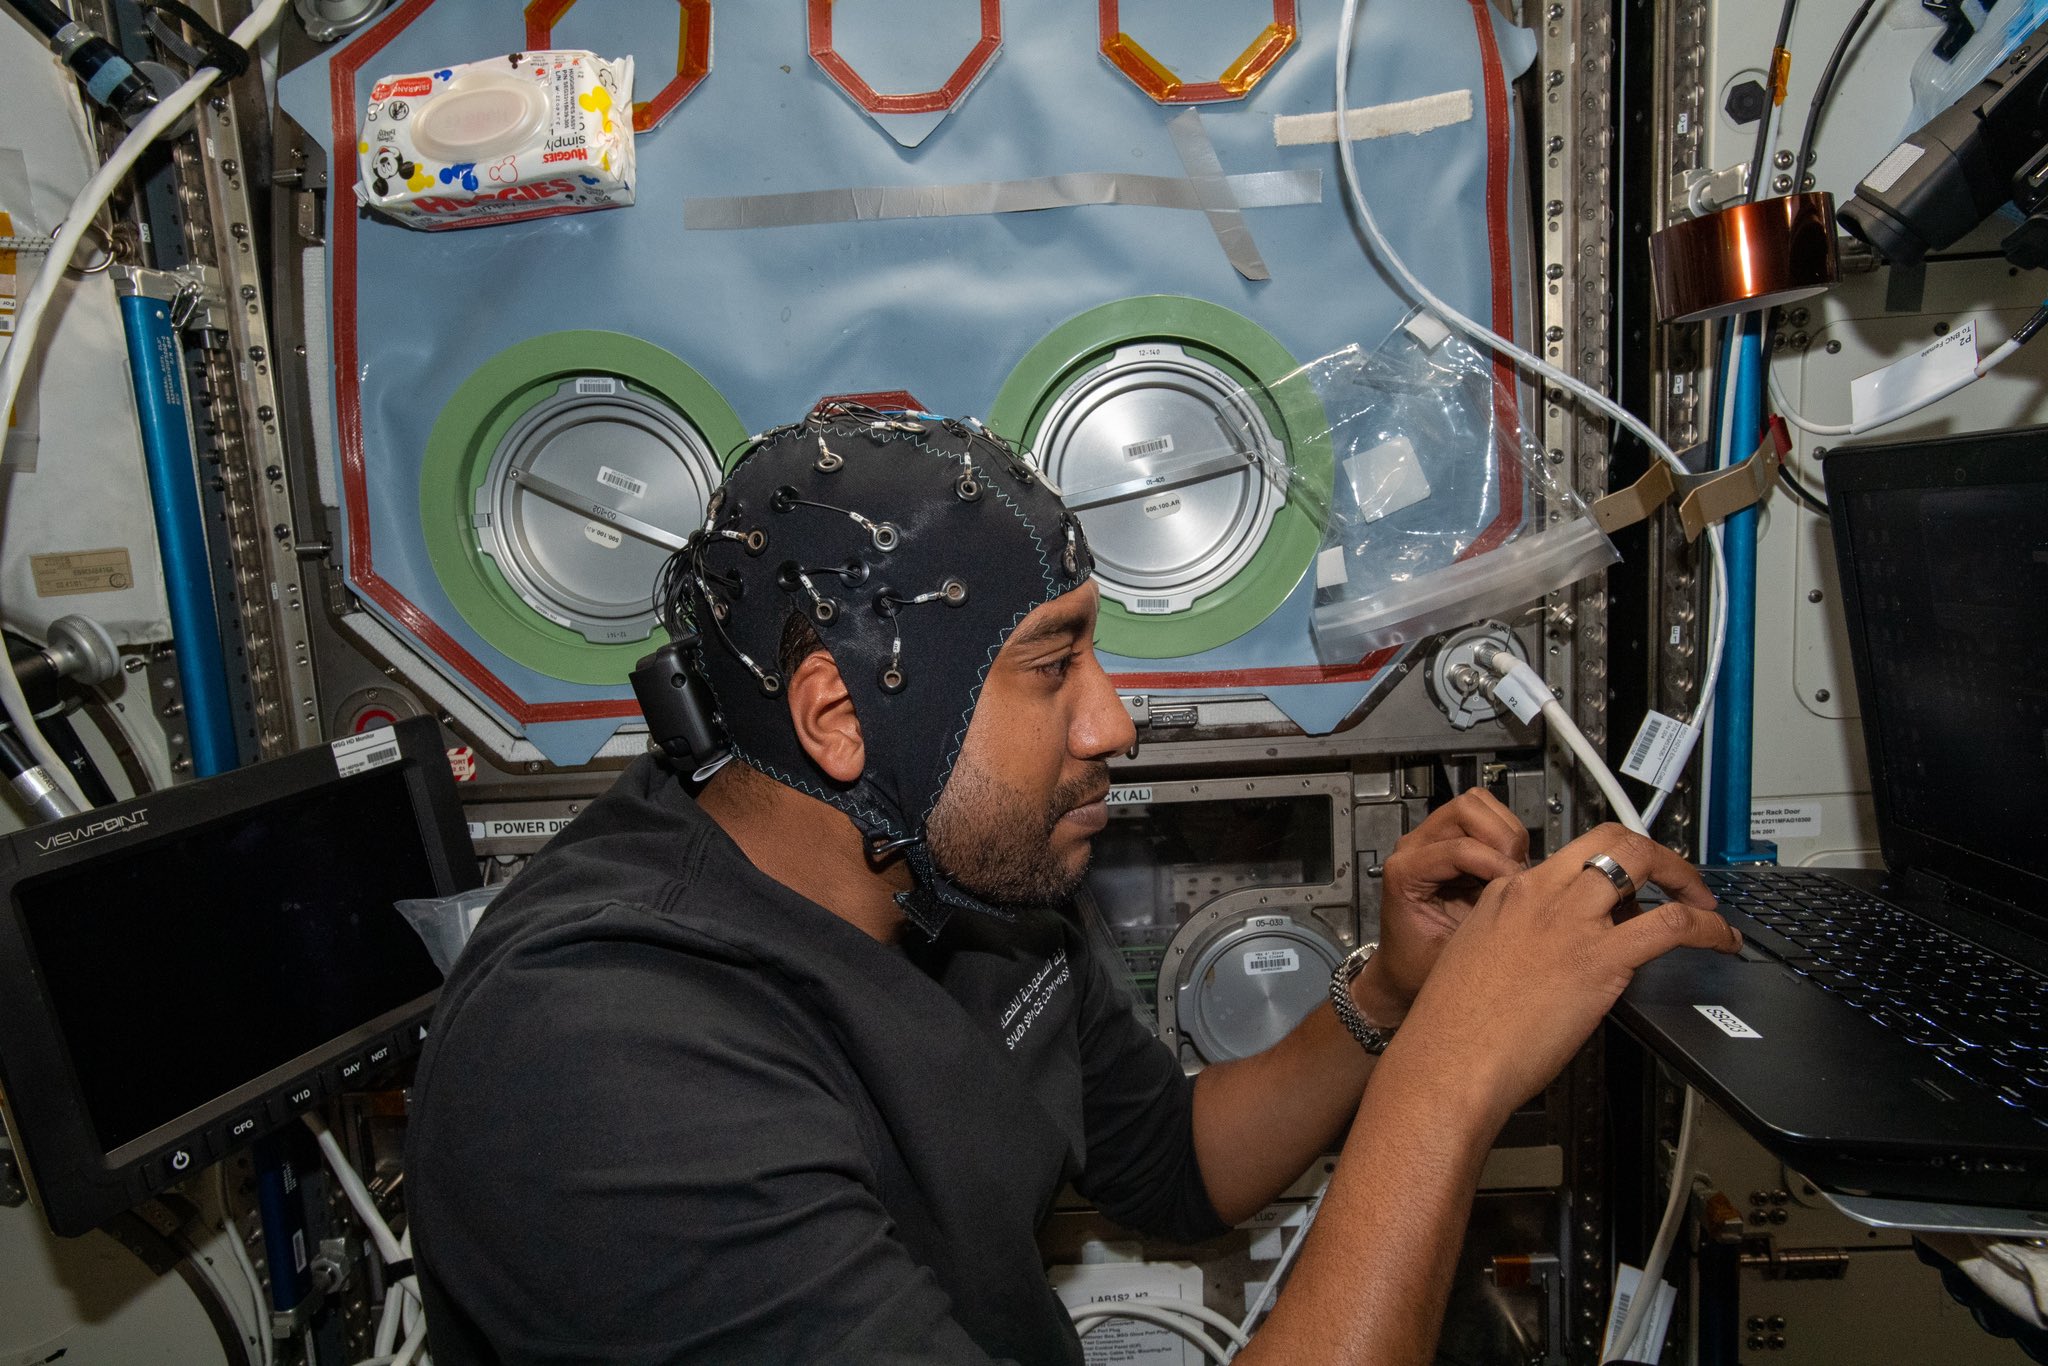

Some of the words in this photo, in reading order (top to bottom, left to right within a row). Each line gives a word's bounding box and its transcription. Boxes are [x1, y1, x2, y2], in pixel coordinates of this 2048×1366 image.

[544, 135, 586, 151] simply
[542, 148, 588, 164] HUGGIES
[1961, 326, 1971, 334] To
[1945, 332, 1961, 345] BNC
[1959, 334, 1972, 347] P2
[1920, 340, 1944, 358] Female
[591, 505, 616, 519] 00-102
[1145, 498, 1180, 514] 500.100.AR
[606, 631, 627, 639] 12-141
[1508, 696, 1518, 708] P2
[355, 732, 374, 741] Monitor
[35, 808, 148, 850] VIEWPOINT
[494, 821, 545, 834] POWER
[550, 821, 570, 831] DIS
[1255, 917, 1284, 929] 05-039
[1023, 1000, 1044, 1028] SPACE
[1705, 1007, 1749, 1033] SSC23
[343, 1062, 361, 1078] DAY
[371, 1047, 388, 1063] NGT
[292, 1088, 311, 1103] VID
[233, 1118, 254, 1136] CFG
